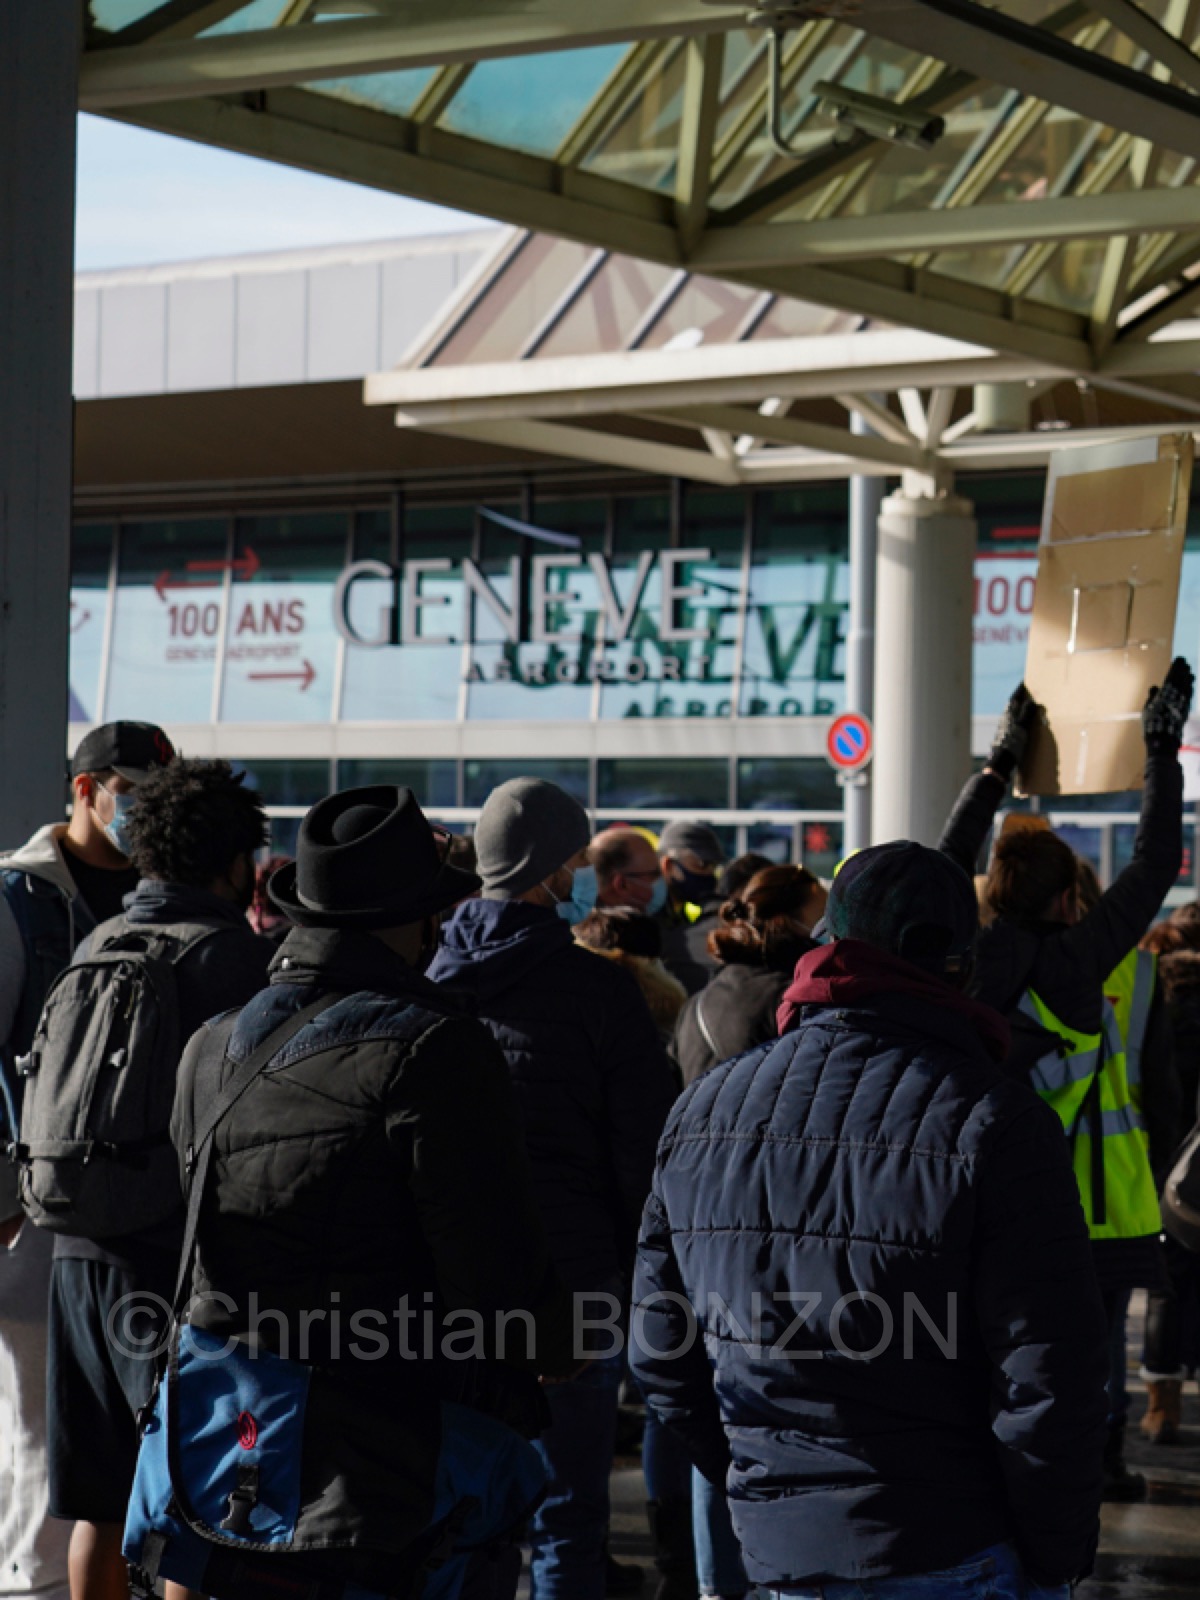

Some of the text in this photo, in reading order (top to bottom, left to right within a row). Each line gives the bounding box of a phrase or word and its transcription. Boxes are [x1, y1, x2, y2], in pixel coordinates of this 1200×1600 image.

[973, 574, 1037, 616] 100
[168, 599, 306, 637] 100 ANS
